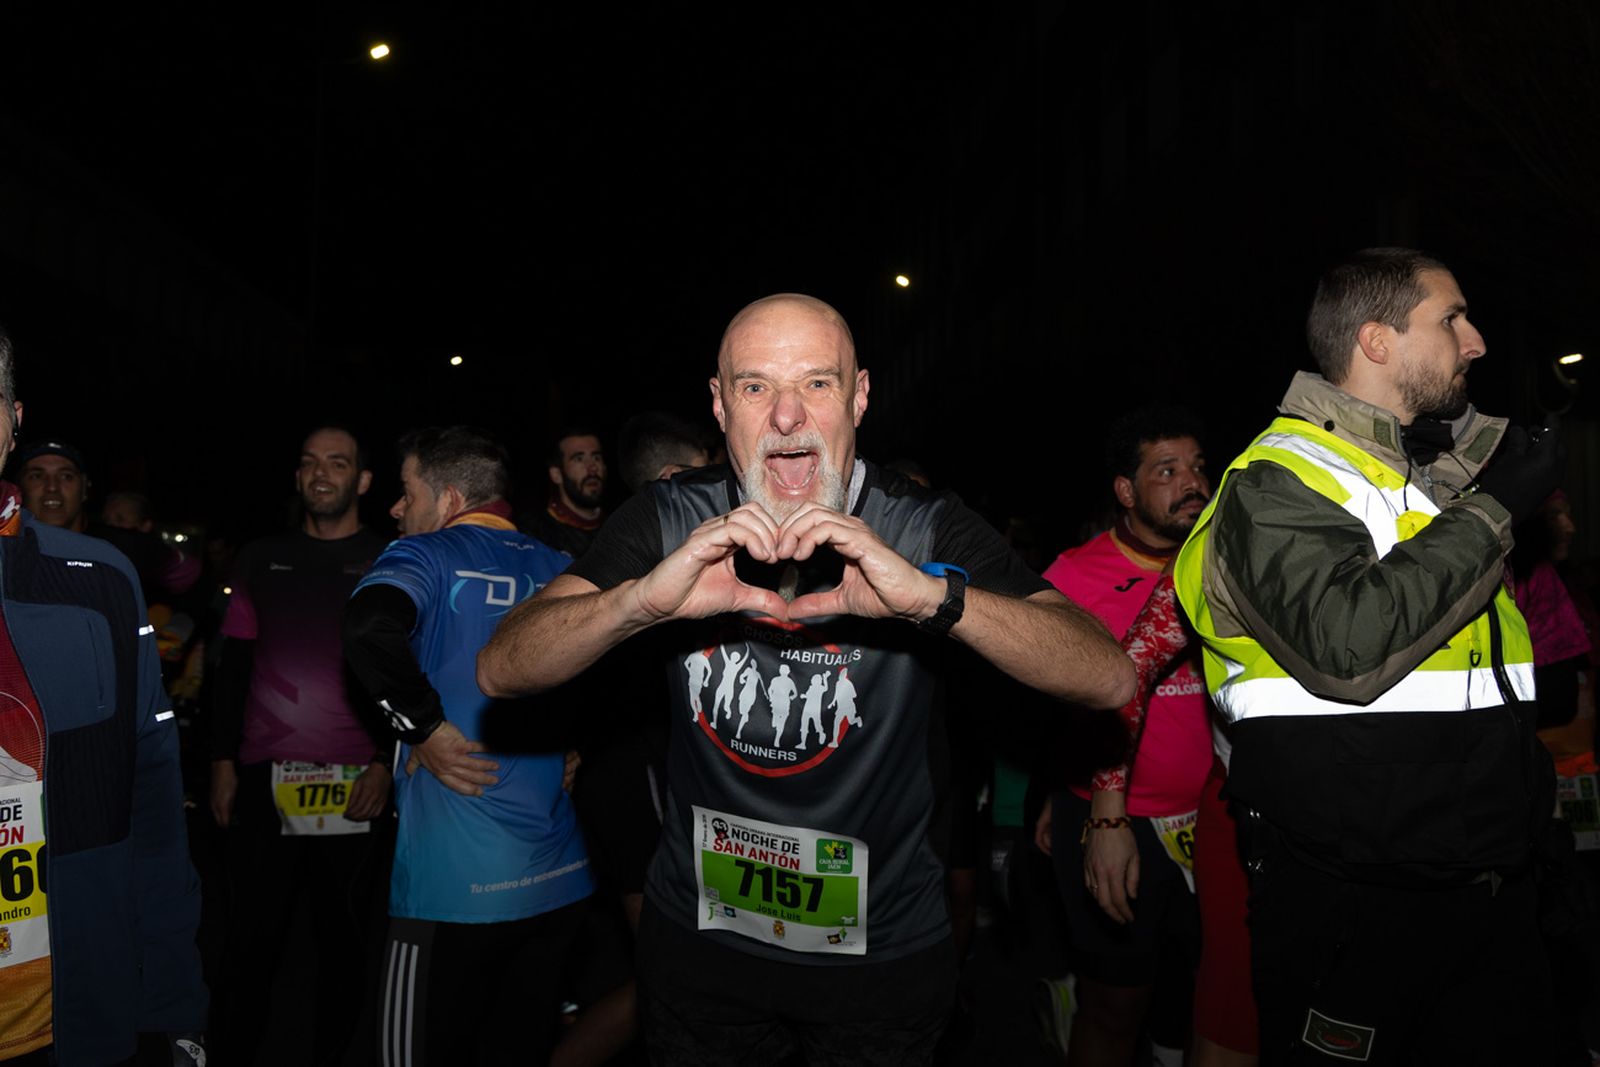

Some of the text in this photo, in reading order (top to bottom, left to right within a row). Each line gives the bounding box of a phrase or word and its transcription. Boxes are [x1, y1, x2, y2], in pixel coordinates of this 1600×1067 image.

[1155, 683, 1203, 697] COLOR
[730, 738, 798, 762] RUNNERS
[296, 783, 346, 807] 1776
[0, 804, 22, 823] DE
[0, 824, 24, 847] ÓN
[732, 828, 800, 855] NOCHE DE
[1176, 828, 1195, 860] 6
[713, 836, 800, 870] SAN ANTÓN
[470, 884, 482, 893] Tu
[484, 879, 518, 892] centro
[520, 876, 532, 887] de
[735, 859, 824, 913] 7157
[756, 904, 801, 921] Jose Luis
